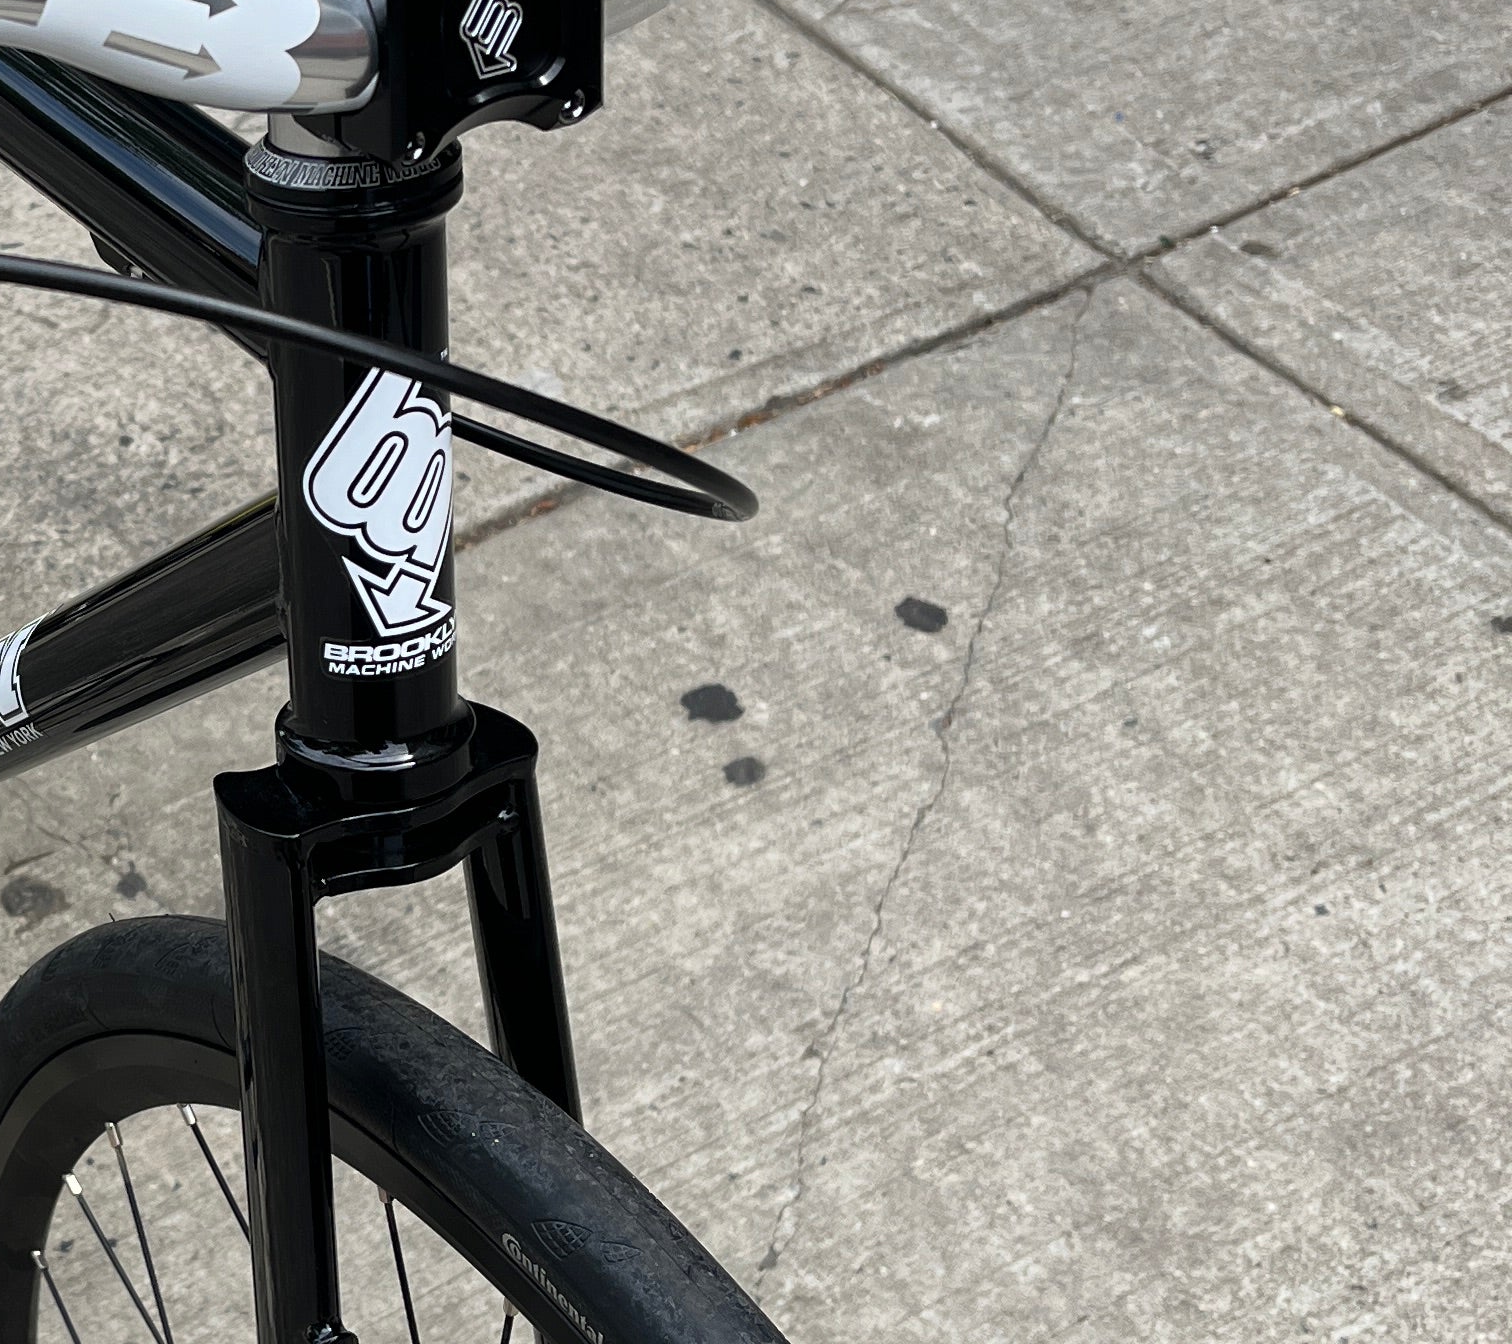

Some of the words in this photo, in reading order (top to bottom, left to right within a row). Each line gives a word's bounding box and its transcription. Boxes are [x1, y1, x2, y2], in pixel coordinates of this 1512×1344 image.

[324, 617, 456, 662] BROOKLY
[328, 654, 426, 676] MACHINE
[8, 722, 44, 748] YORK
